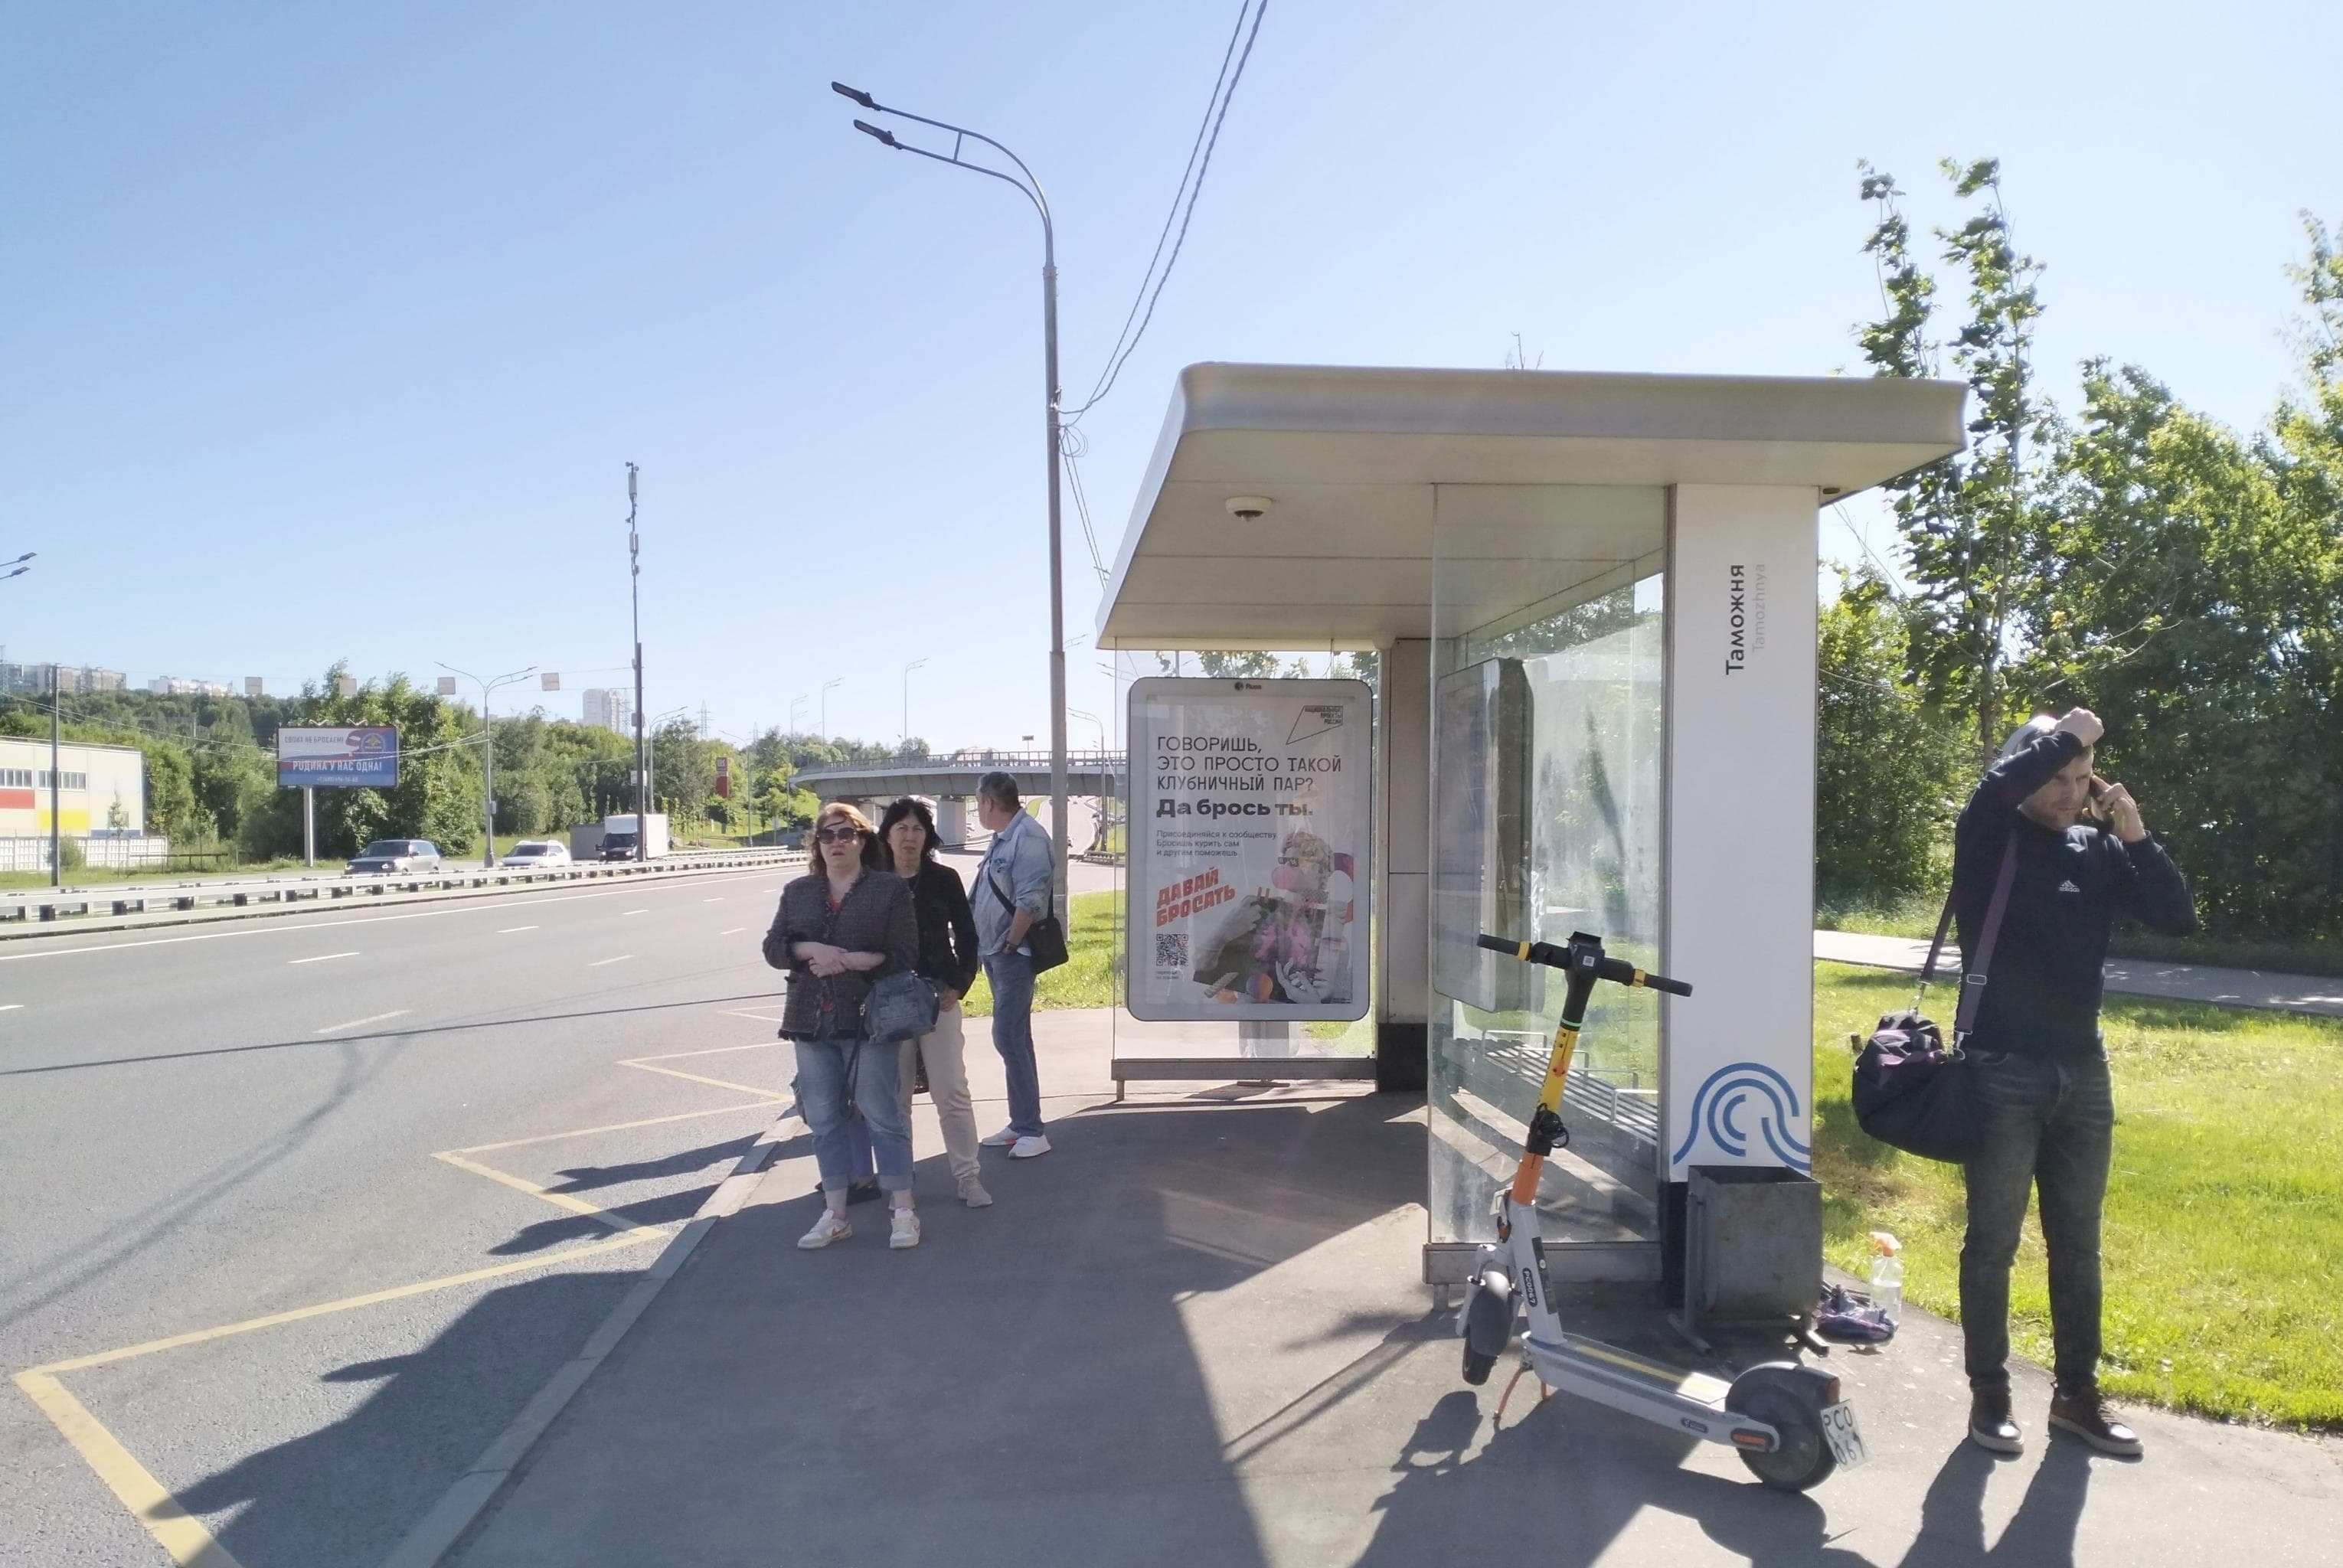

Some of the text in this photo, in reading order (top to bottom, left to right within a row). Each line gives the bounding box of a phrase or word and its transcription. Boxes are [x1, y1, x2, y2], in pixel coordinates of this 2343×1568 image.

[1752, 564, 1768, 653] Tamozhnya
[1725, 565, 1745, 675] Таможня
[1157, 736, 1263, 753] ГОВОРИШЬ,
[292, 760, 382, 773] РОДИНА У НАС ОДНА!
[1157, 754, 1341, 773] ЭТО ПРОСТО ТАКОЙ
[1273, 776, 1314, 792] ПАР?
[1156, 799, 1313, 820] Да брось ты.
[1156, 830, 1221, 838] Присоединяйся
[1156, 866, 1219, 910] ДАВАЙ
[1156, 884, 1236, 927] БРОСАТЬ
